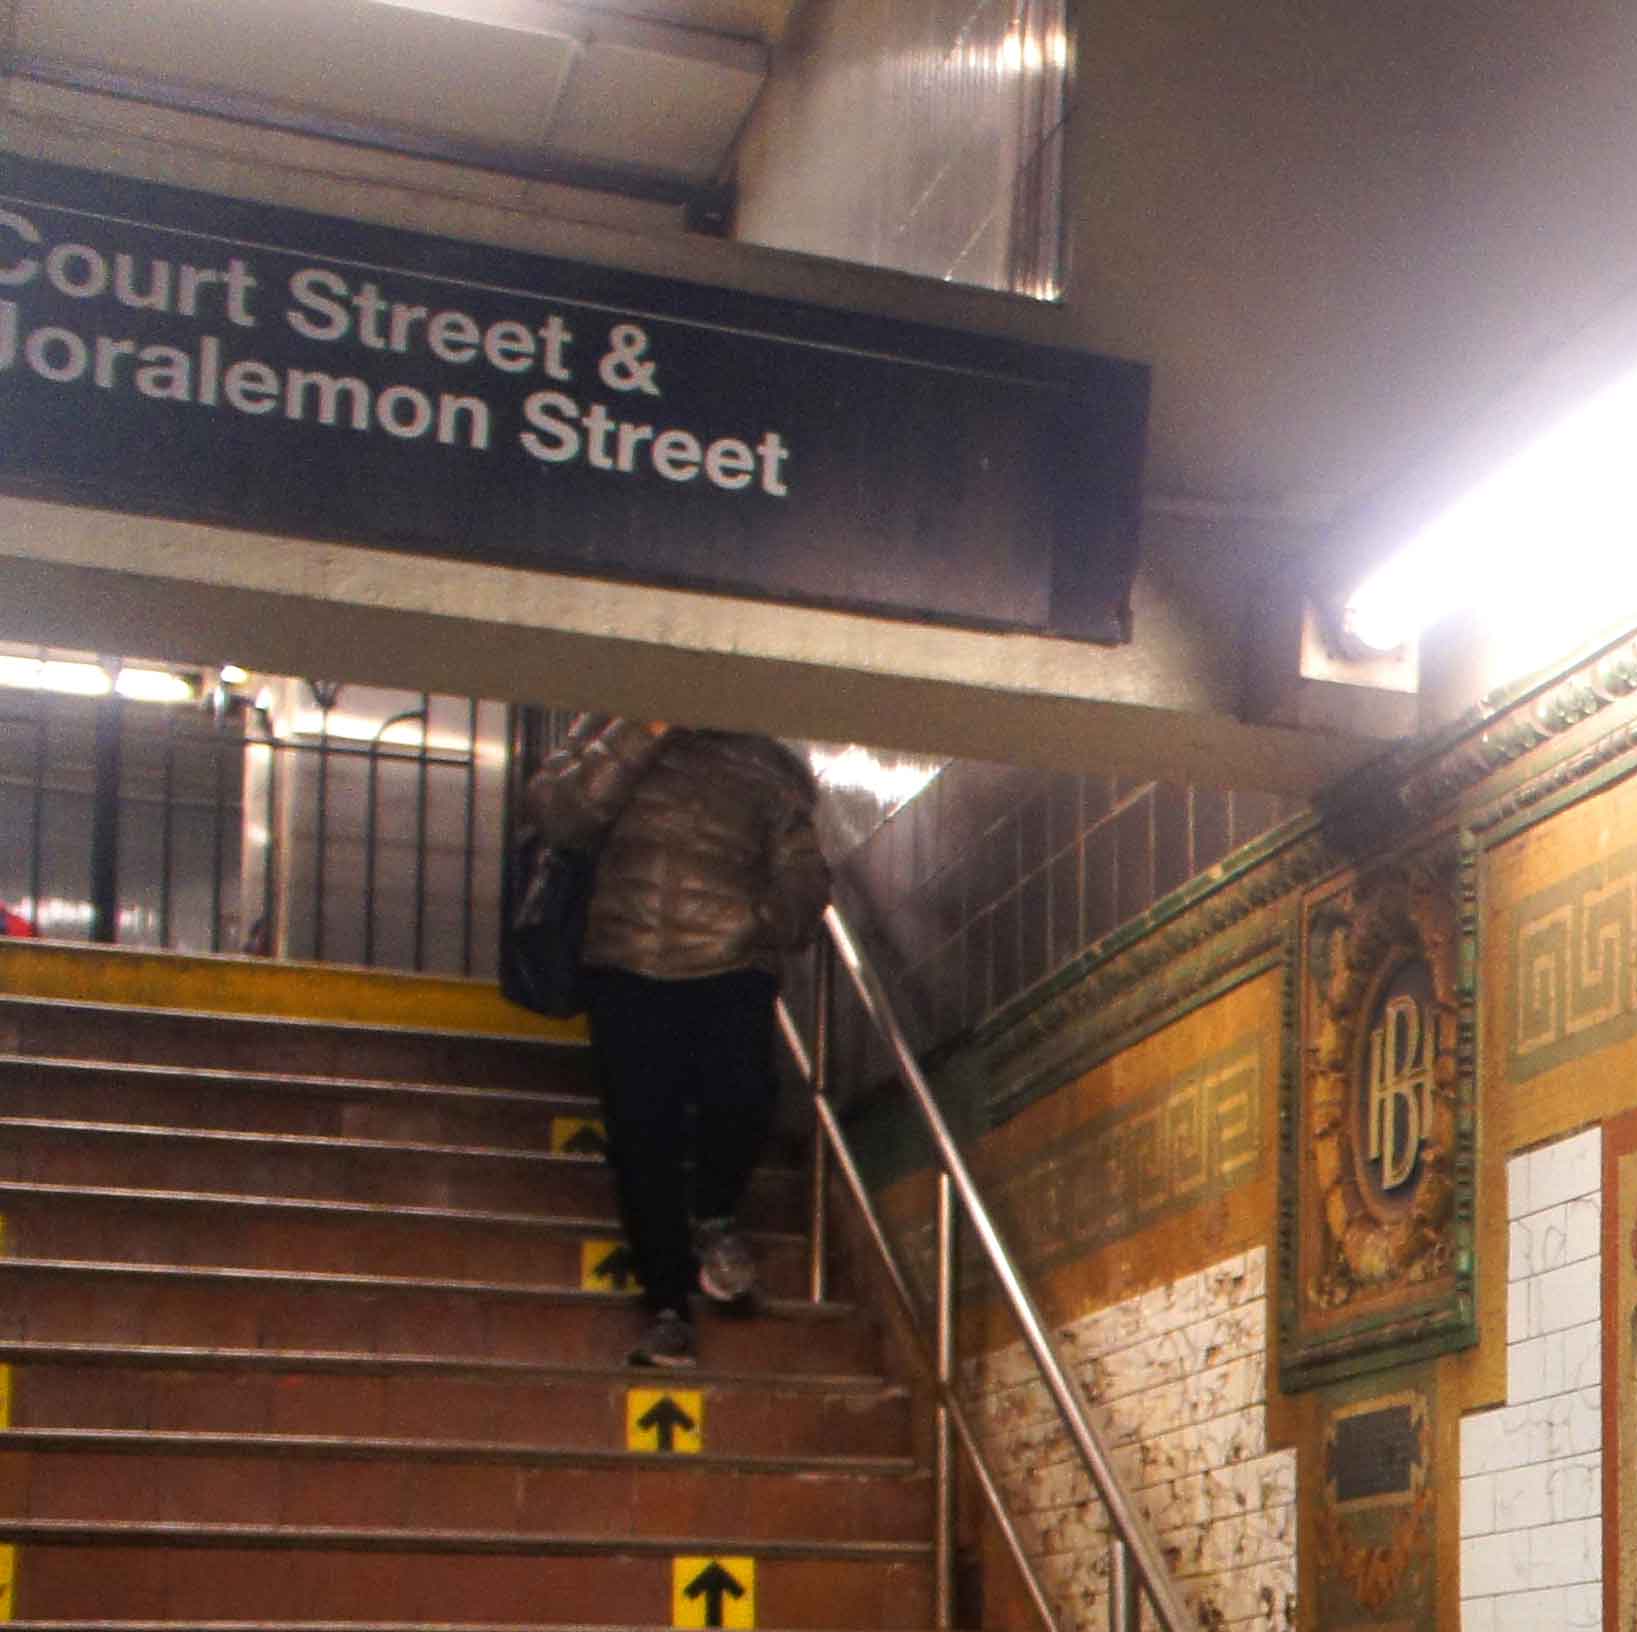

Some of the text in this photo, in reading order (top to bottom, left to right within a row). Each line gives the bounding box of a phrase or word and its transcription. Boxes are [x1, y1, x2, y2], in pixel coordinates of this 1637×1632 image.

[0, 207, 662, 397] Court Street &
[519, 389, 790, 497] Street
